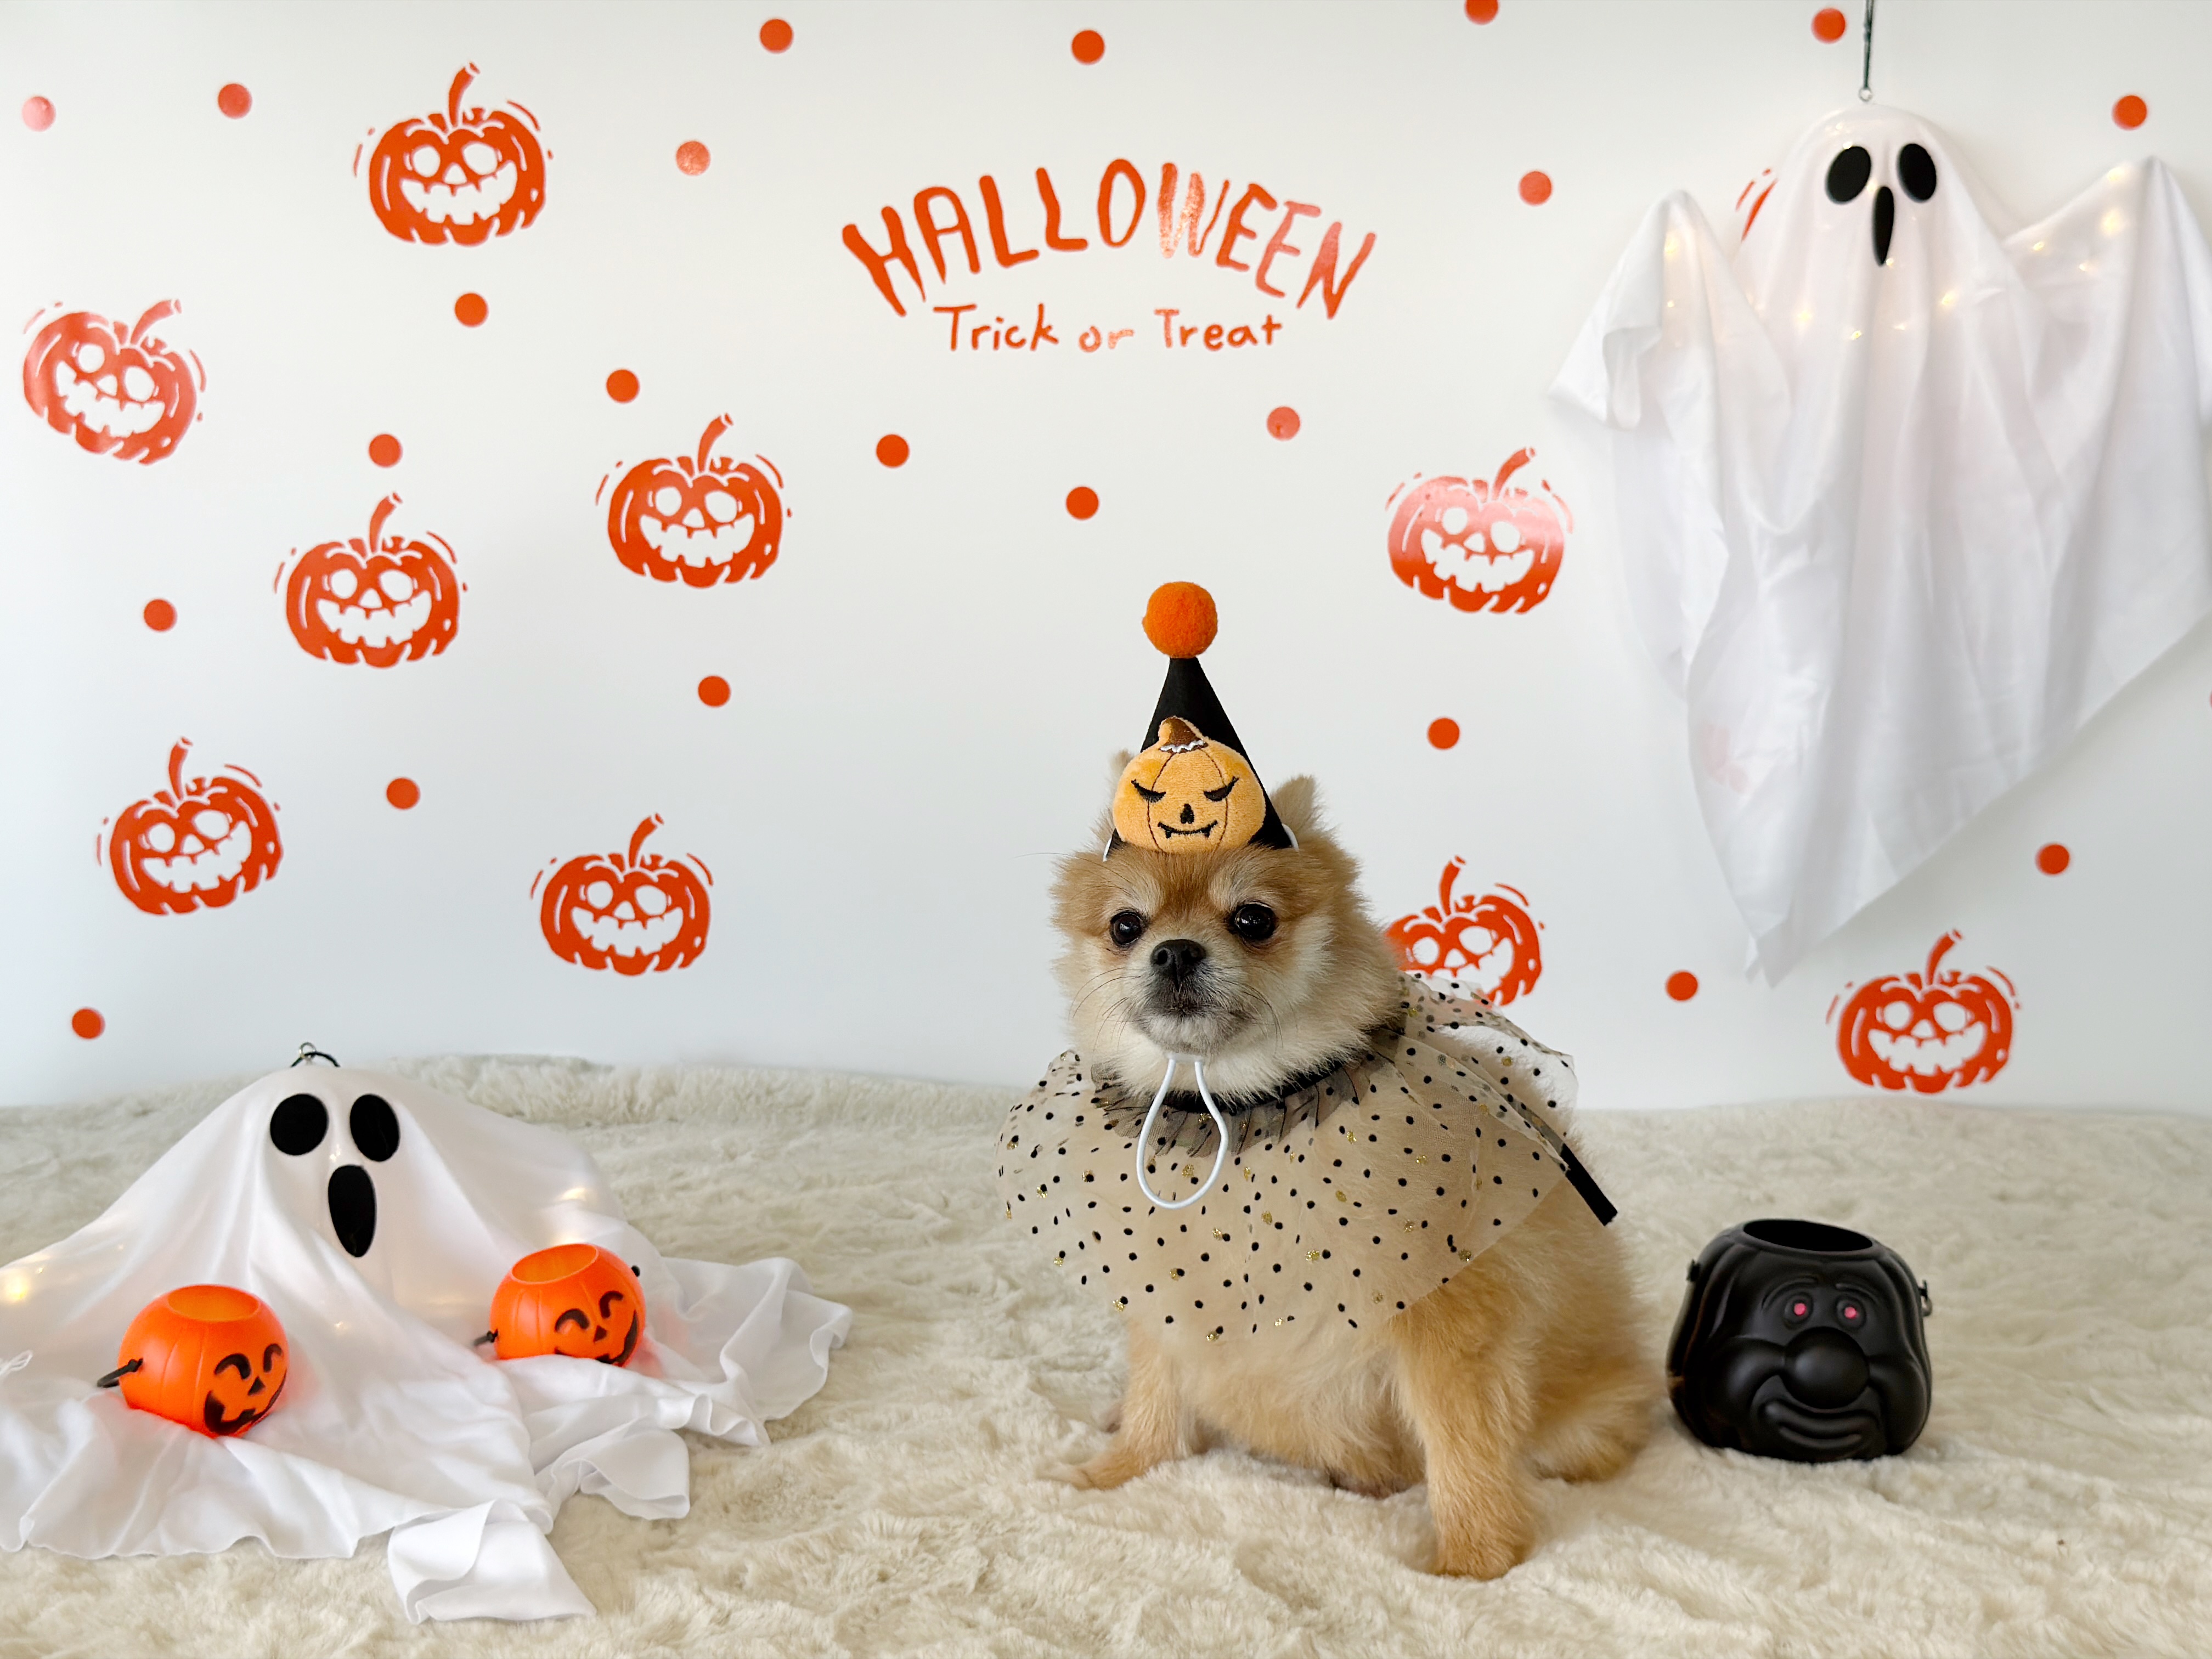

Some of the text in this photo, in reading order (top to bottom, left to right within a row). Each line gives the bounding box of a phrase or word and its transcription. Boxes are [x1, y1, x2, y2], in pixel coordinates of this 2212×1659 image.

[842, 158, 1377, 320] HALLOWEEN
[932, 303, 1283, 353] Trick or Treat
